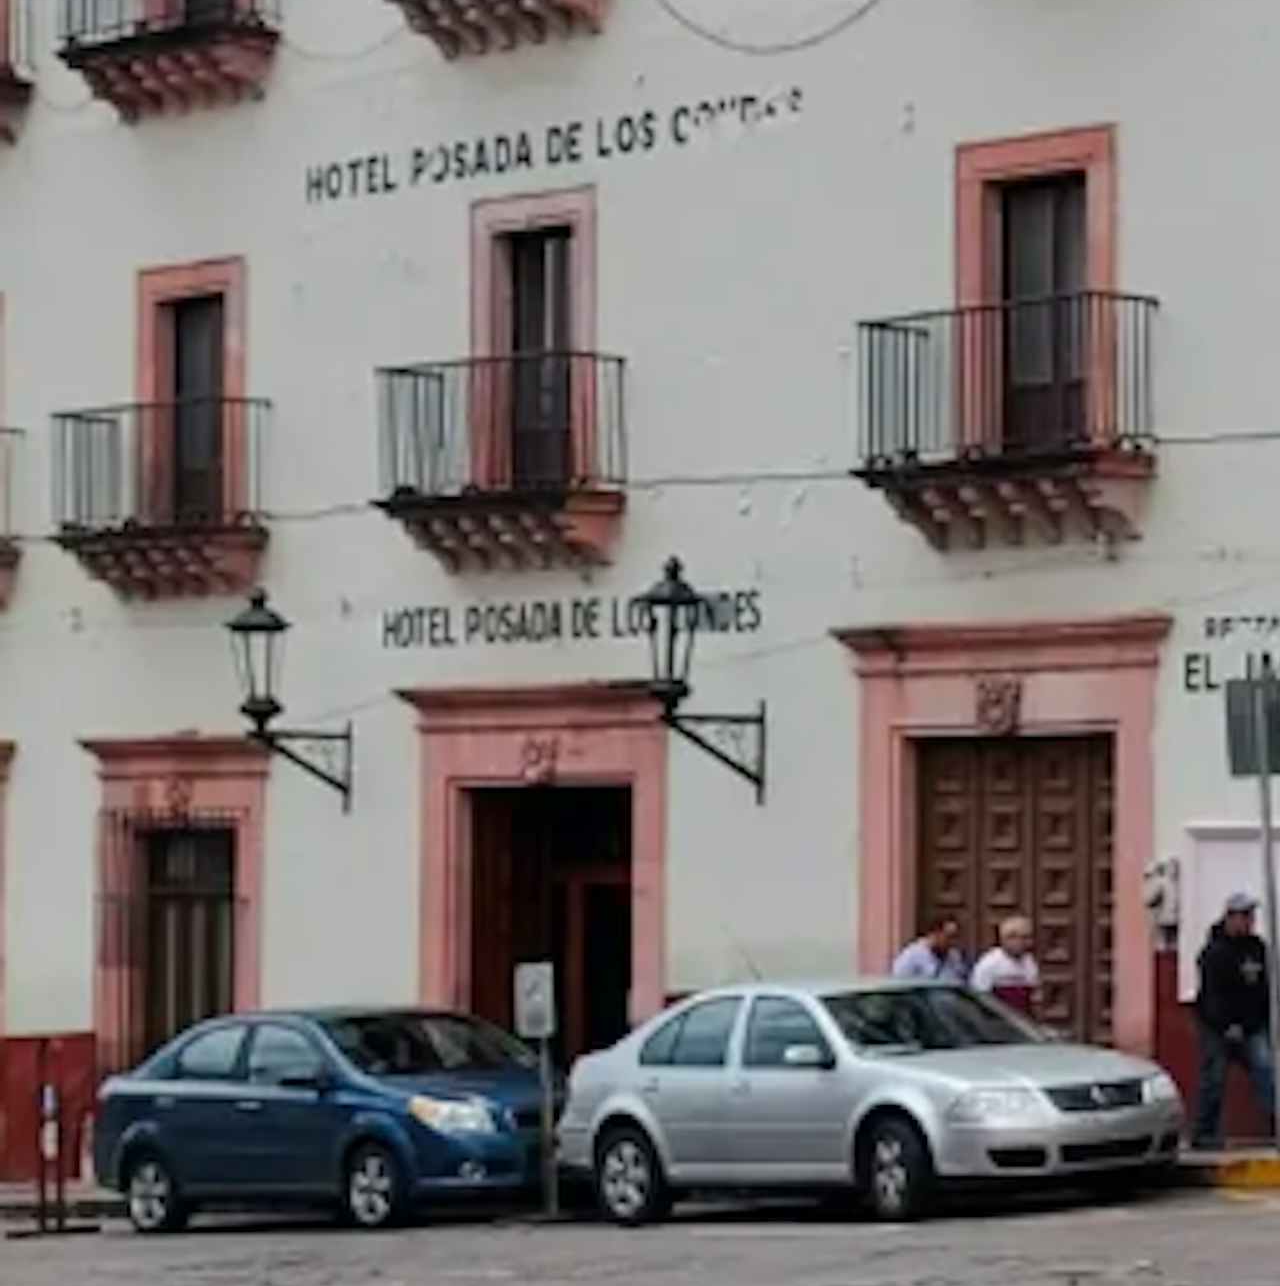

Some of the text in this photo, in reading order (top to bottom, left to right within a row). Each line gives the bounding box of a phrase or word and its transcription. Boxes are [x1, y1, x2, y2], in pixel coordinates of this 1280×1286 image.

[305, 153, 397, 203] HOTEL
[411, 131, 532, 185] POSADA
[546, 122, 583, 165] DE
[597, 110, 656, 159] LOS
[382, 605, 456, 649] HOTEL
[465, 601, 561, 645] POSADA
[572, 596, 602, 639] DE
[1184, 652, 1220, 692] EL
